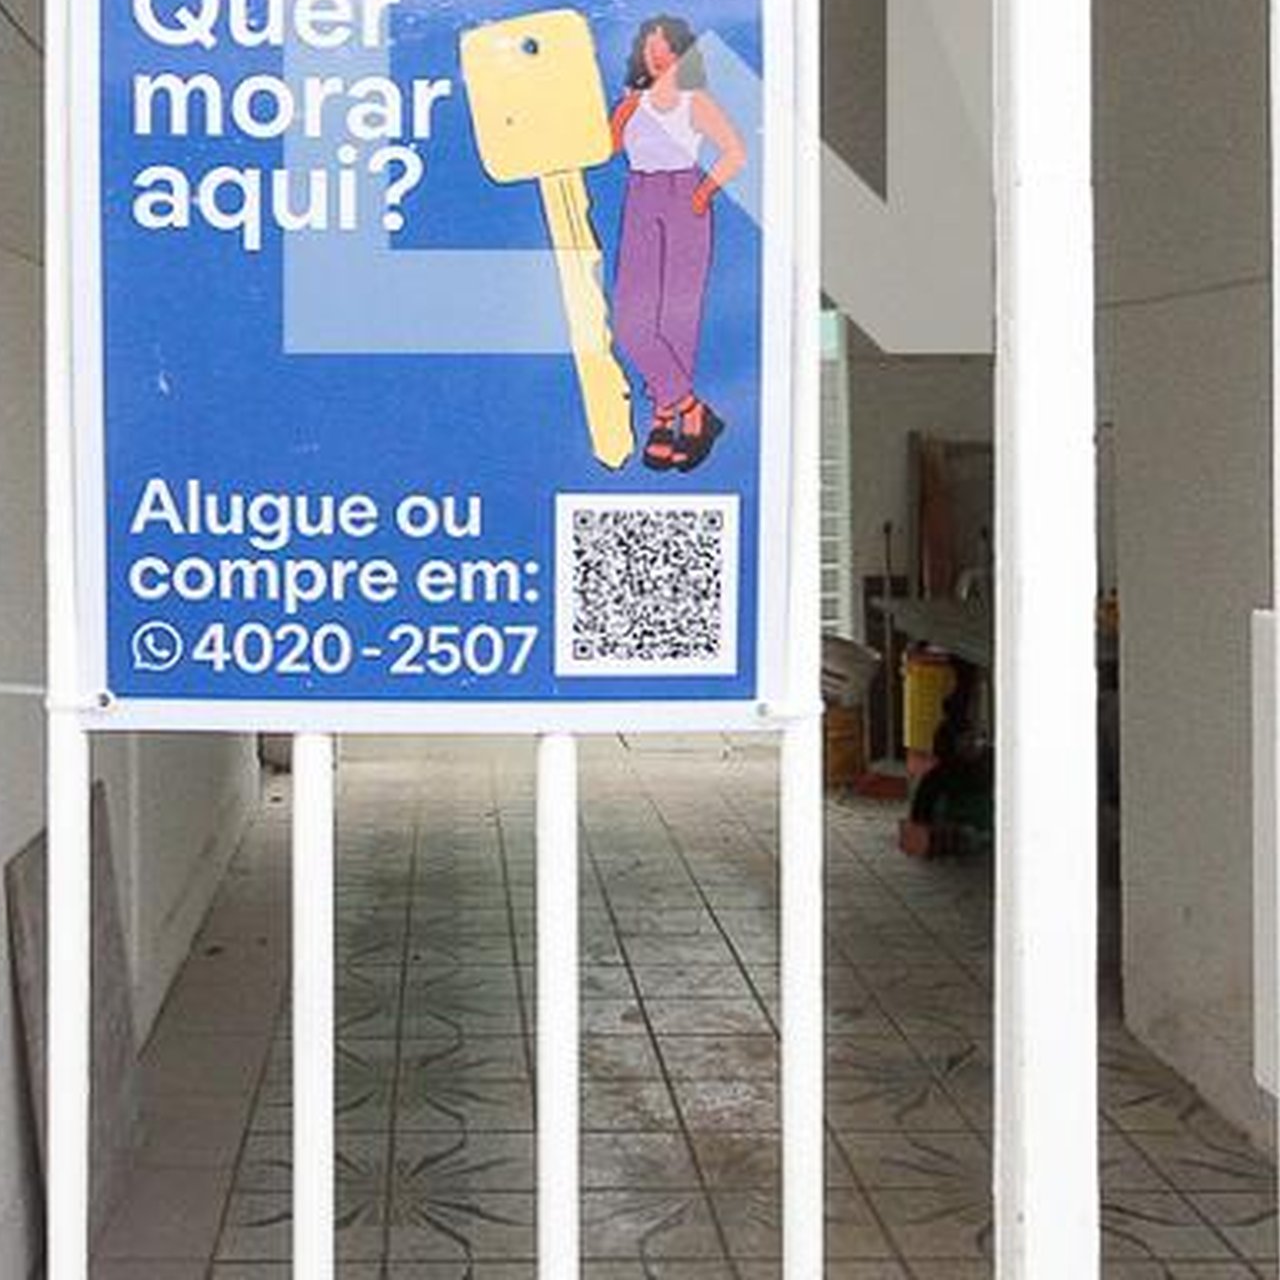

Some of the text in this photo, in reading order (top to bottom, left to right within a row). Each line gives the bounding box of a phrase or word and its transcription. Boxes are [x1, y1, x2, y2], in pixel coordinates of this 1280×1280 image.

[132, 74, 451, 138] morar
[132, 146, 423, 252] aqui?
[130, 479, 481, 550] Alugue ou
[128, 556, 540, 613] compre em:
